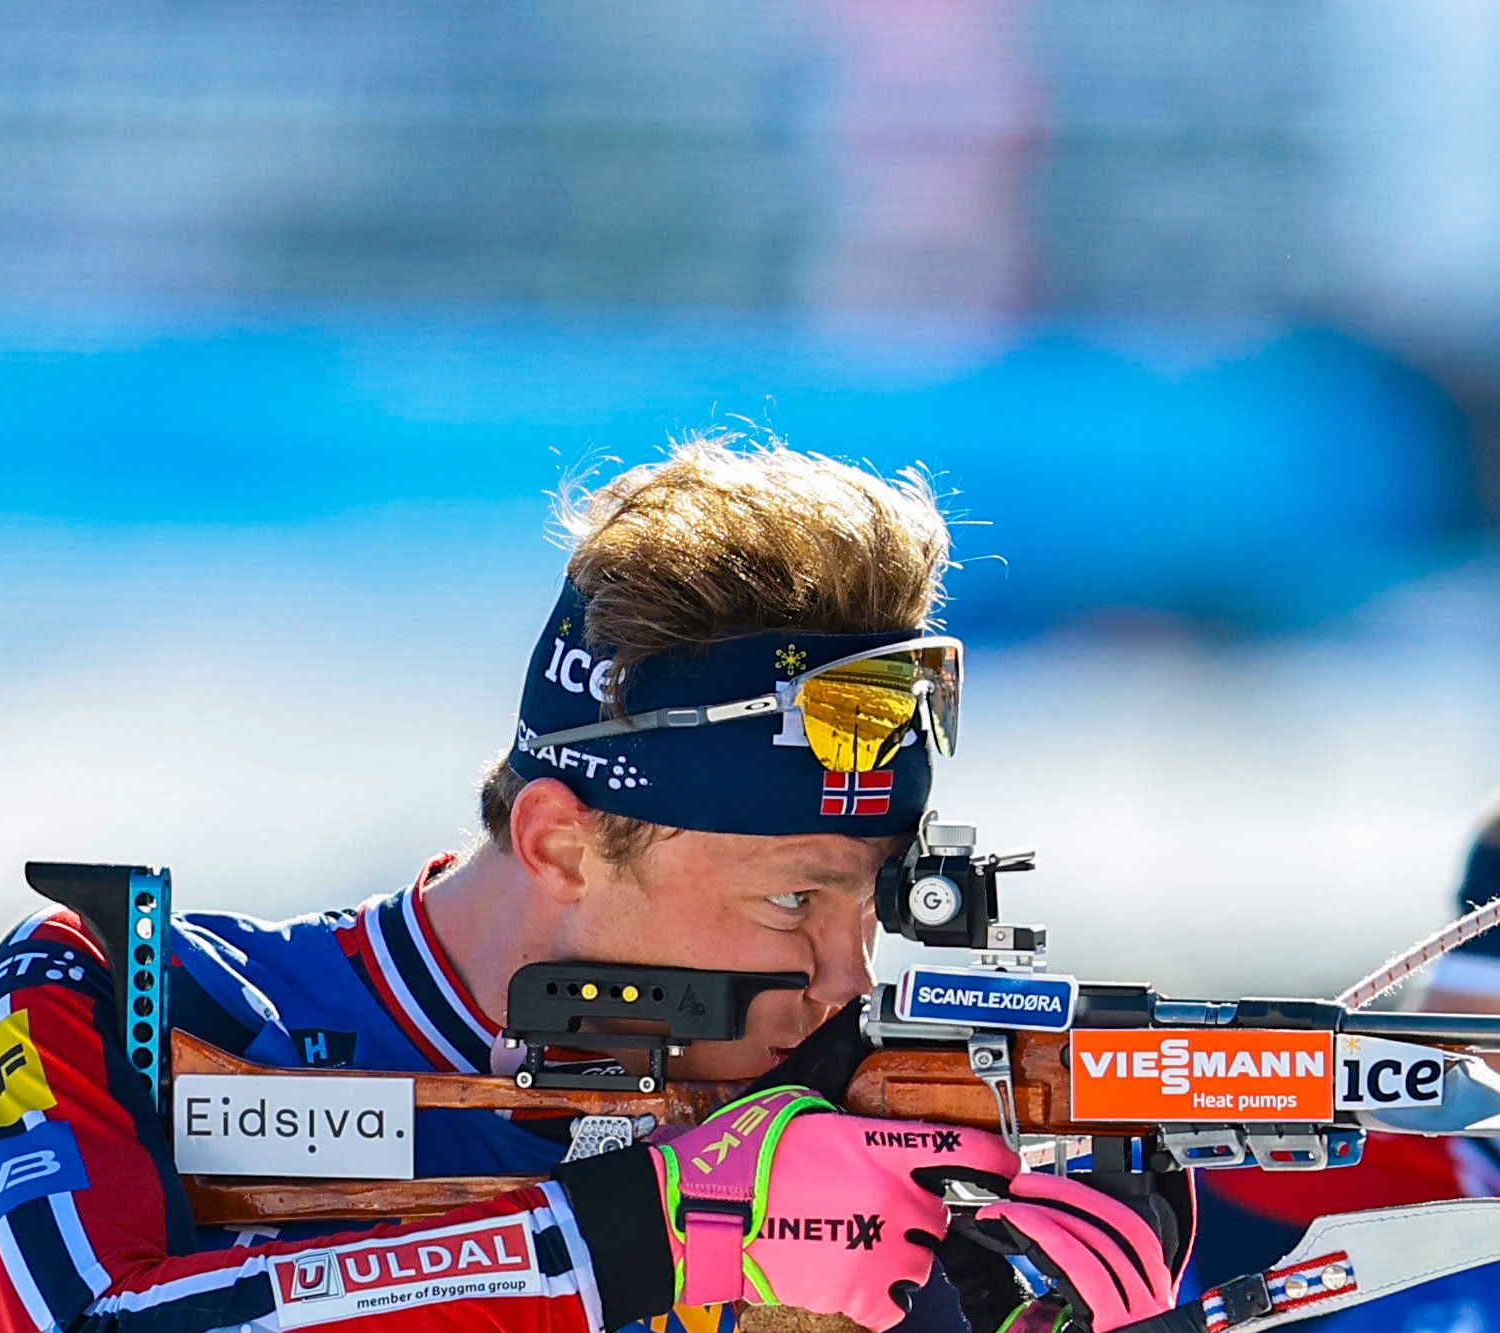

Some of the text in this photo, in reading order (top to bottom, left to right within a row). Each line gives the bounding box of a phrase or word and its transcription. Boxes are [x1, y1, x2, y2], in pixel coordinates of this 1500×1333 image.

[917, 986, 1062, 1014] SCANFLEXDØRA
[1192, 1091, 1298, 1112] Heat pumps
[345, 1235, 523, 1283] ULDAL
[357, 1279, 526, 1309] member of Byggma group
